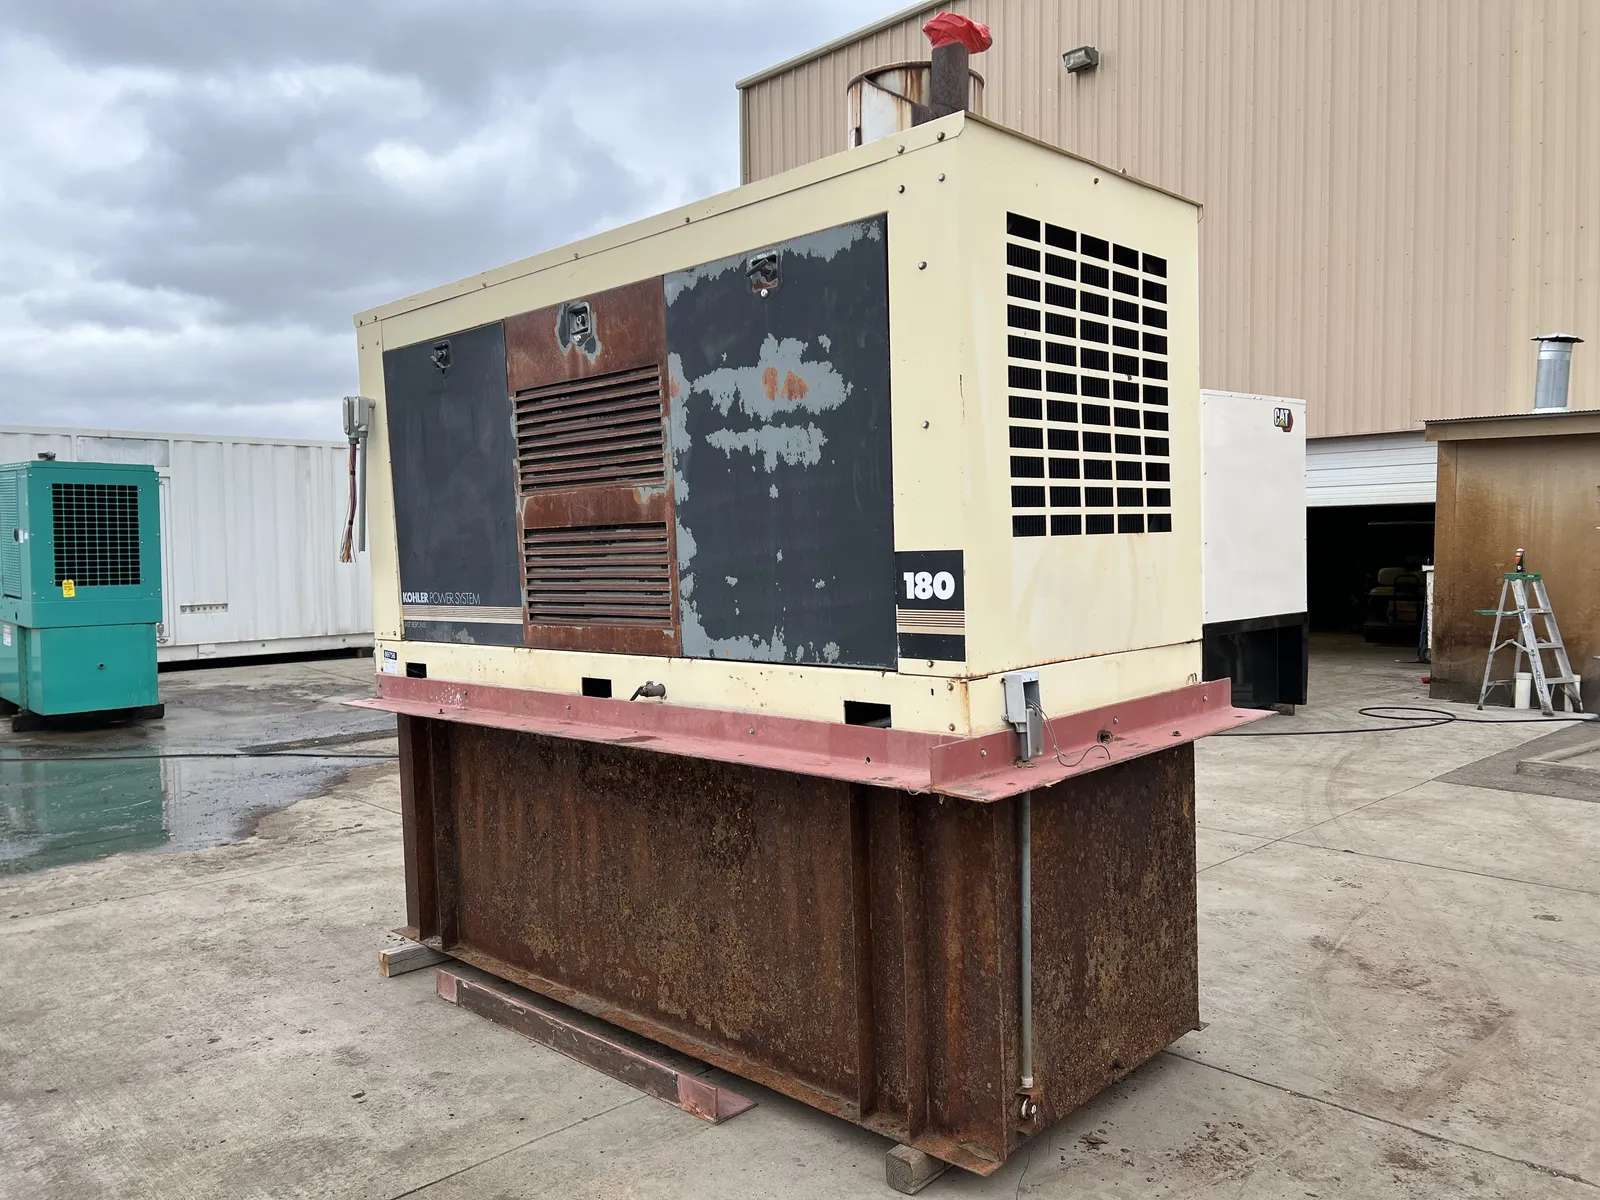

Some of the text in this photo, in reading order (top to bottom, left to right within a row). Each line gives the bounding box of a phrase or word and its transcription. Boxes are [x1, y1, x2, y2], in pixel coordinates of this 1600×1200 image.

[1274, 408, 1289, 427] CAT
[903, 571, 955, 600] 180
[402, 592, 480, 604] KOHLER POWER SYSTEM
